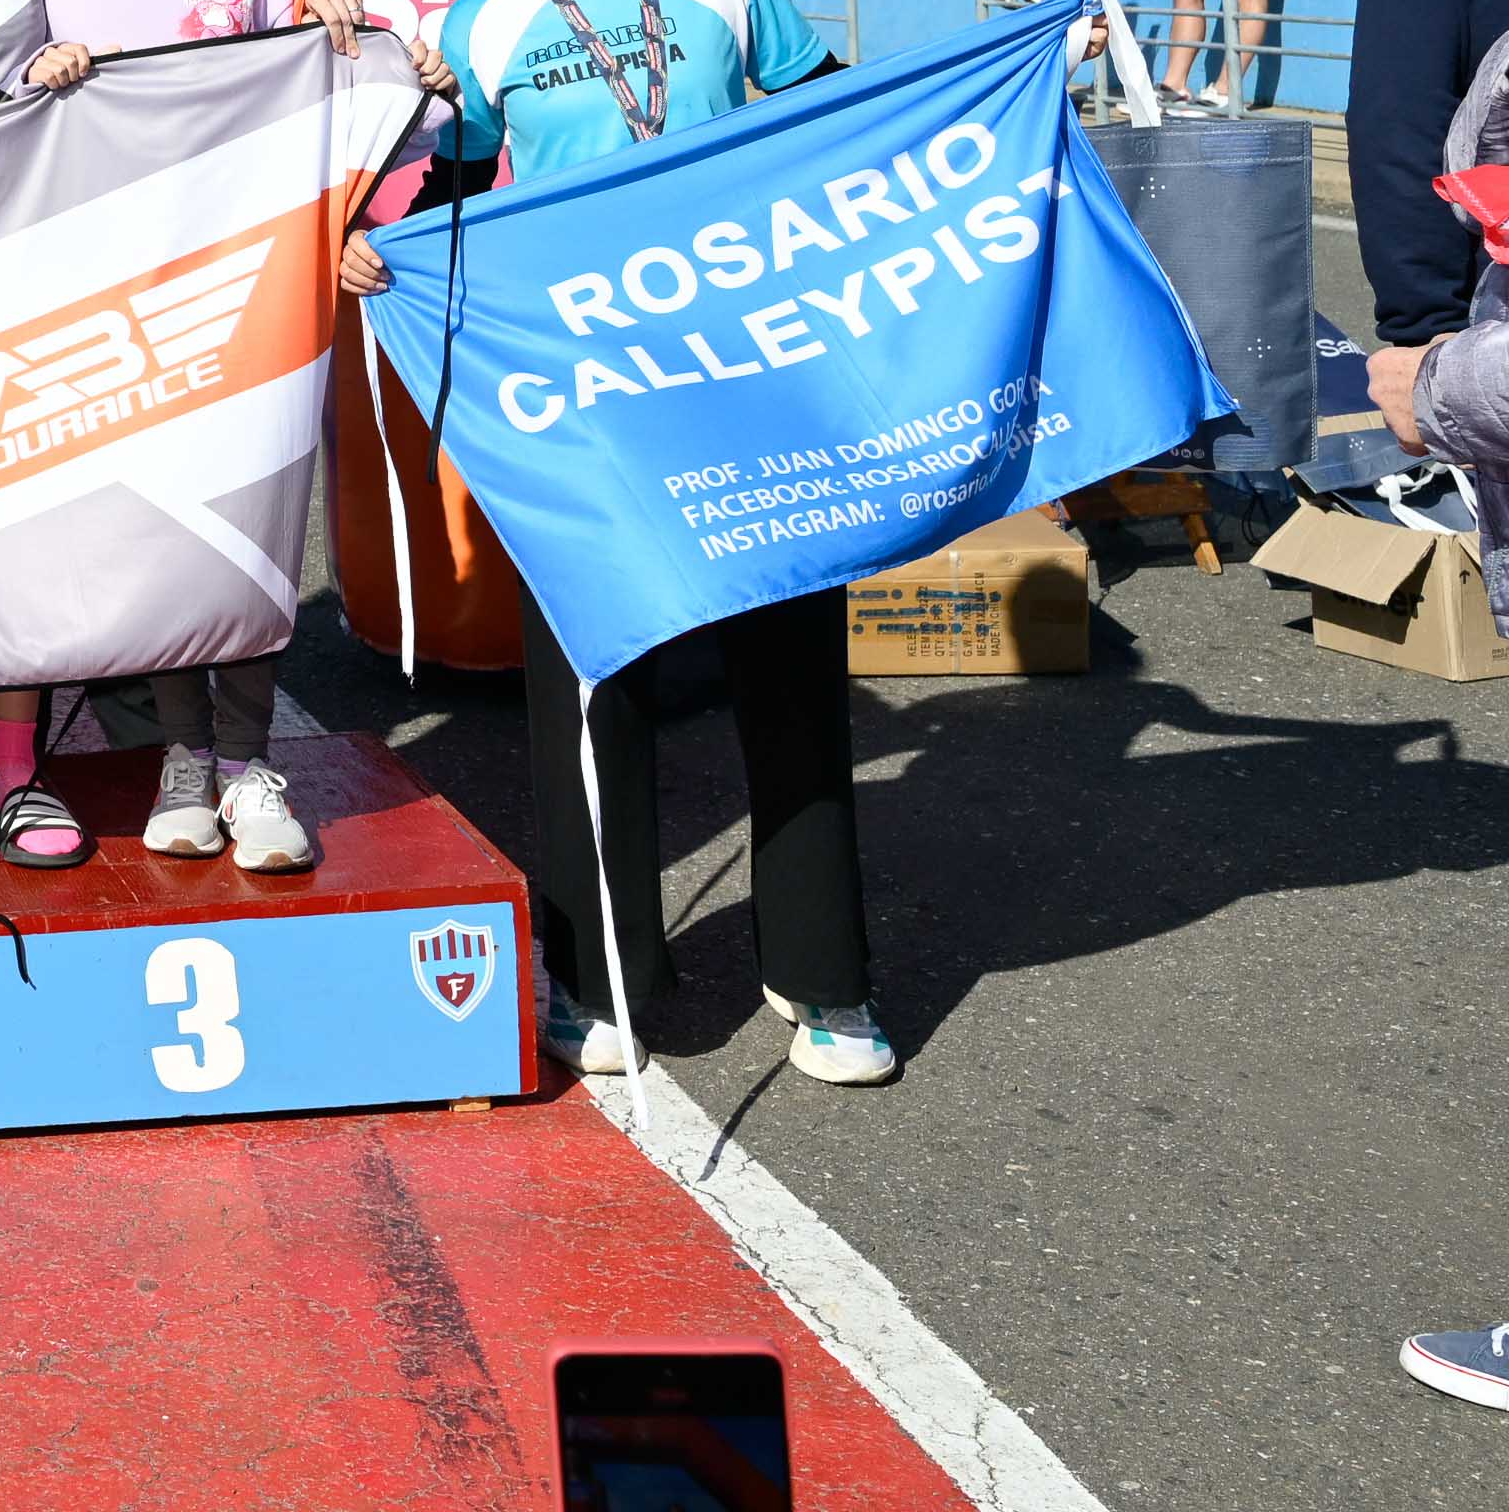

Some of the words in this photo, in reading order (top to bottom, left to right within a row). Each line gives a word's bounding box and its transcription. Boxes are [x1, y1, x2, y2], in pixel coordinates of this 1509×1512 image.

[526, 17, 677, 68] ROSARO
[533, 43, 686, 91] CALLEPISA
[547, 122, 996, 337] ROSARIO
[663, 462, 754, 499] PROF.
[760, 448, 834, 480] JUAN
[835, 399, 984, 465] DOMINGO
[681, 476, 844, 529] FACEBOOK:
[699, 498, 886, 560] INSTAGRAM:
[990, 632, 1001, 657] MADE
[144, 937, 245, 1093] 3
